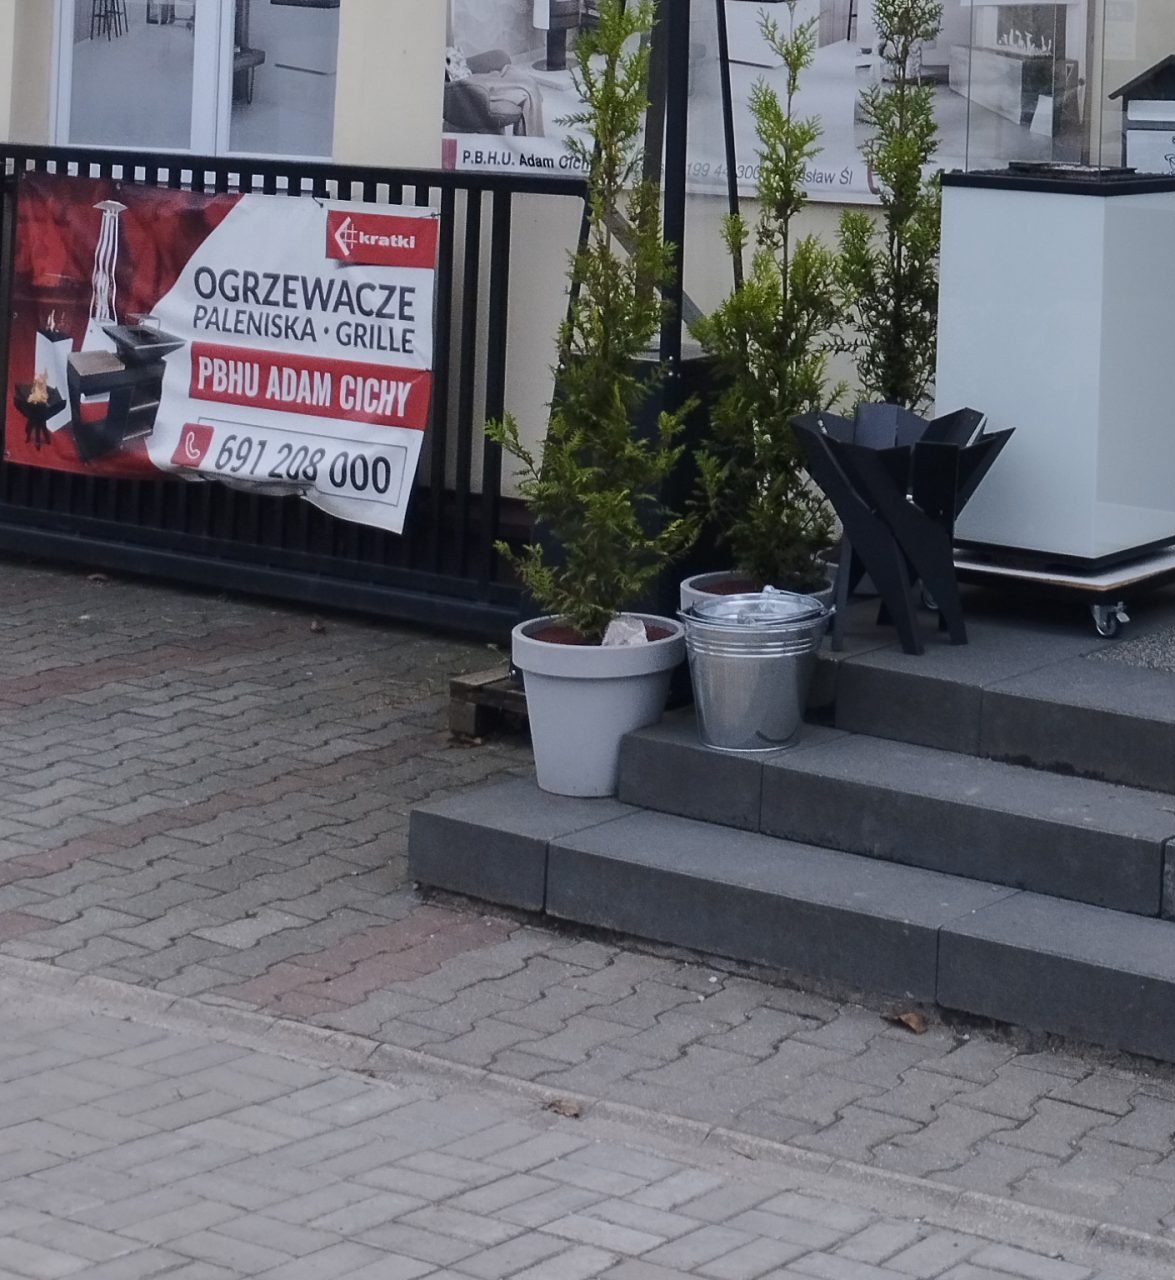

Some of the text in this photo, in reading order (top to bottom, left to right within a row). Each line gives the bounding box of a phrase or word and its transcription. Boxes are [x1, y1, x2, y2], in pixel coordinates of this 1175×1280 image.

[462, 150, 591, 169] P.B.H.U. Adam Cich
[358, 231, 416, 249] kratki
[193, 266, 416, 322] OGRZEWACZE
[193, 305, 416, 354] PALENISKA GRILLE
[197, 356, 412, 418] PBHU ADAM CICHY
[214, 434, 391, 494] 691 208 000
